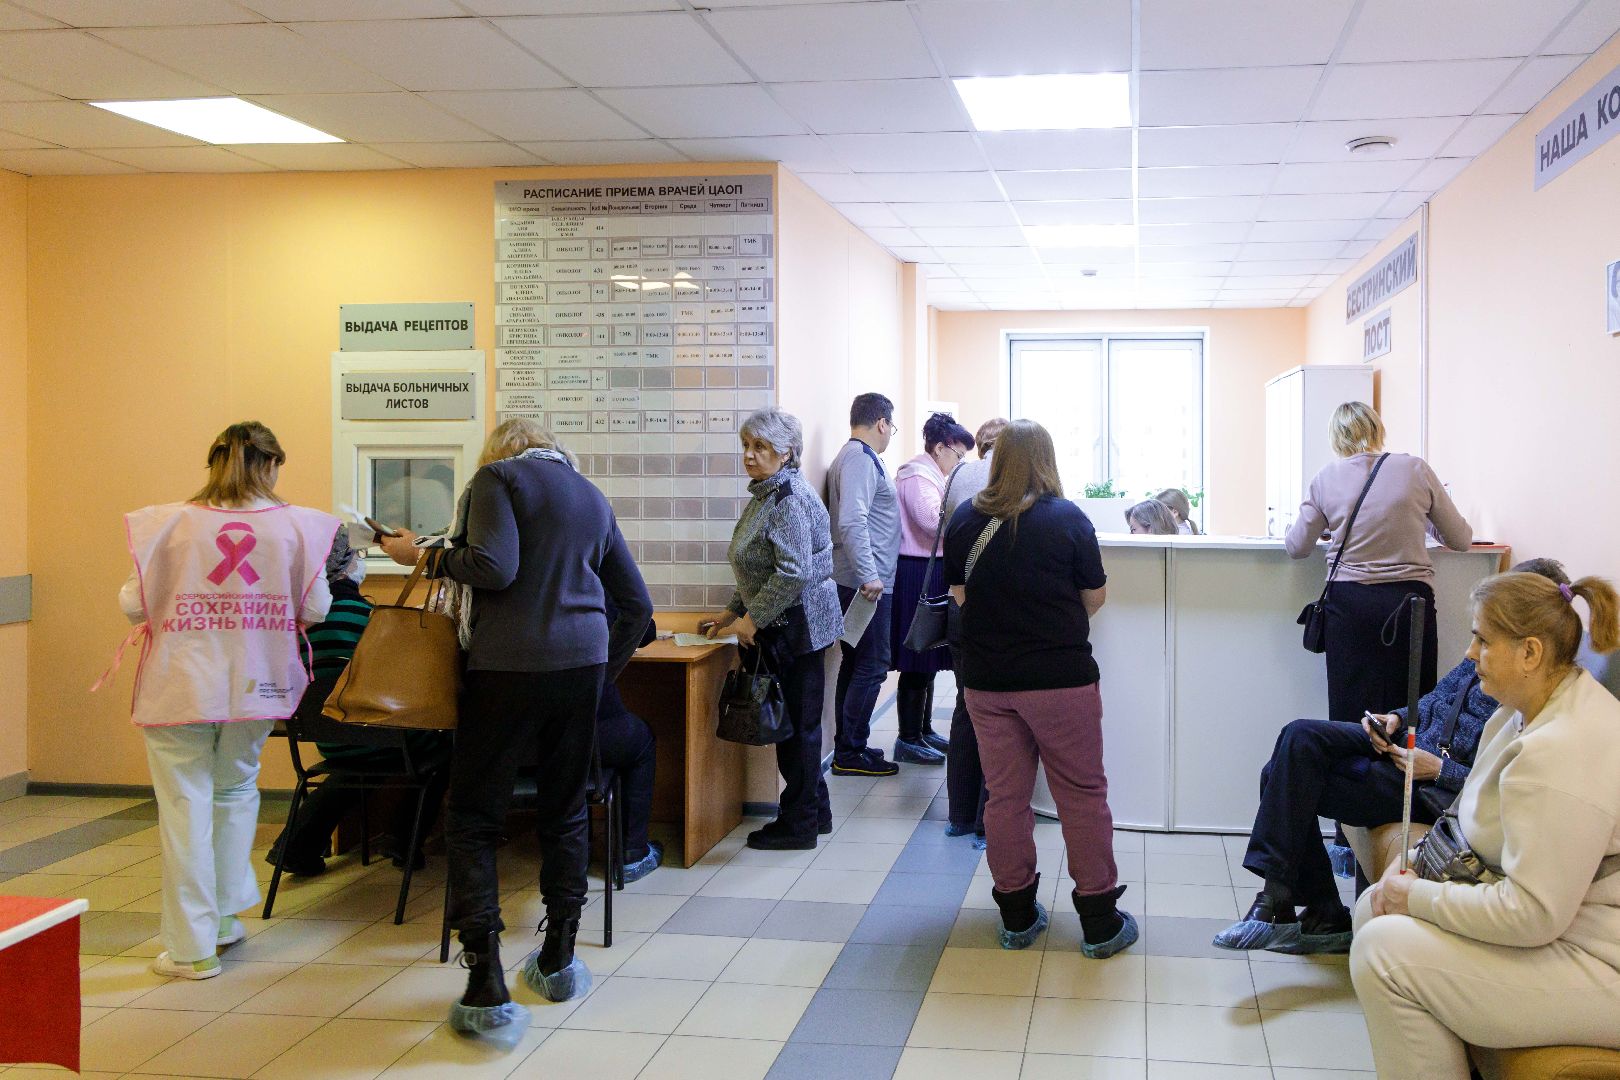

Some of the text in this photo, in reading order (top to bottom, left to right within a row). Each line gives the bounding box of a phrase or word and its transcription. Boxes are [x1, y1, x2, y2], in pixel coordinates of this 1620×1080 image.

[1540, 112, 1588, 172] НАША
[523, 183, 743, 199] РАСПИСАНИЕ ПРИЕМА ВРАЧЕЙ ЦАОП
[1346, 238, 1416, 320] СЕСТРИНСКИЙ
[345, 319, 469, 334] ВЫДАЧА РЕЦЕПТОВ
[1364, 316, 1390, 357] ПОСТ
[346, 382, 469, 395] ВЫДАЧА БОЛЬНИЧНЫХ
[385, 398, 429, 409] ЛИСТОВ
[175, 592, 288, 601] ВСЕРОССИЙСКИЙ ПРОЕКТ
[175, 601, 288, 617] СОХРАНИМ
[161, 616, 296, 633] ЖИЗНЬ МАМЕ
